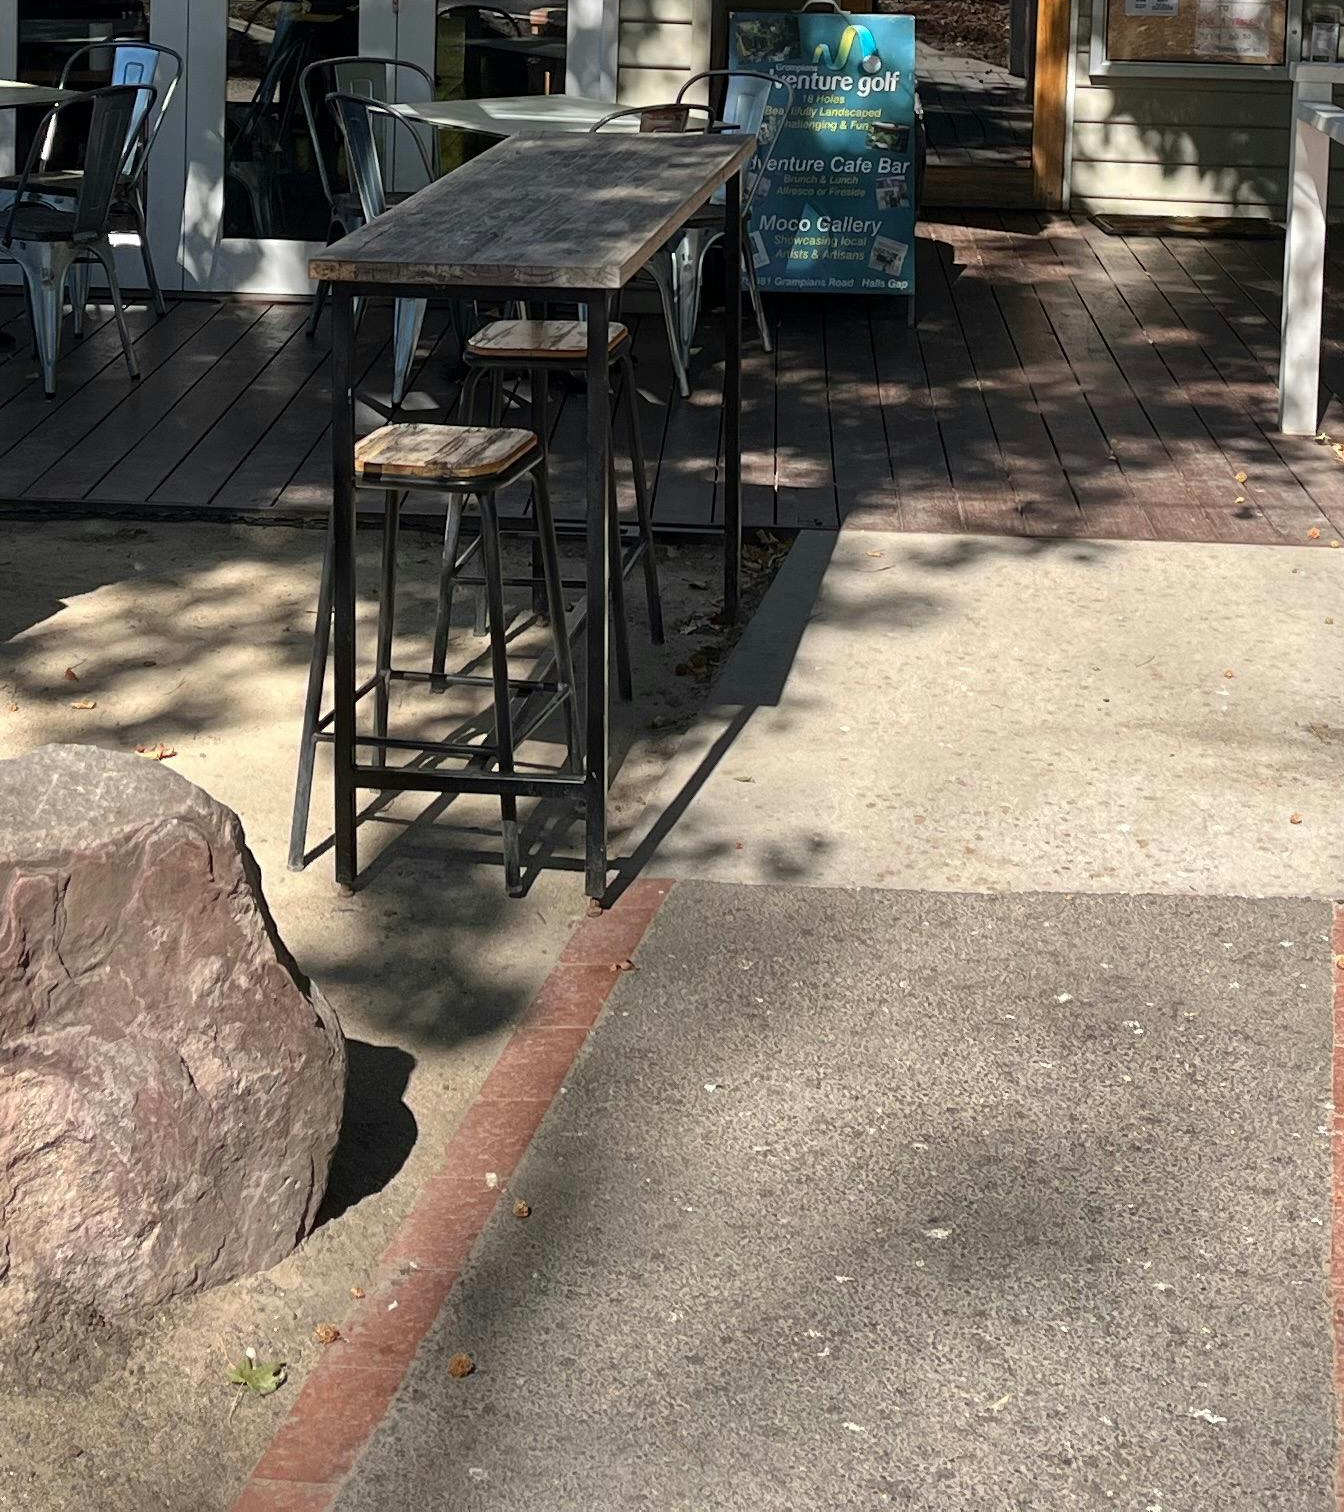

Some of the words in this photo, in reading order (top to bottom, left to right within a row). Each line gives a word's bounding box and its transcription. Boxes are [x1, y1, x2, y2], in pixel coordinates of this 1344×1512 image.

[856, 71, 900, 98] golf
[801, 94, 813, 105] 18
[816, 94, 846, 105] Holes
[819, 105, 882, 118] Landscaped
[837, 120, 848, 130] &
[850, 120, 869, 131] Fun
[830, 155, 873, 174] Cafe
[877, 157, 911, 175] Bar
[783, 175, 817, 185] Brunch
[829, 175, 859, 185] Lunch
[816, 188, 827, 196] or
[759, 214, 811, 232] Moco
[816, 215, 883, 237] Gallery
[774, 234, 838, 249] Showcasing
[839, 235, 868, 246] local
[775, 248, 809, 260] Artists
[810, 249, 819, 260] &
[821, 249, 865, 261] Artisans
[774, 276, 826, 289] Grampians
[828, 277, 855, 288] Road
[861, 278, 885, 288] Halls
[887, 278, 909, 290] Gap
